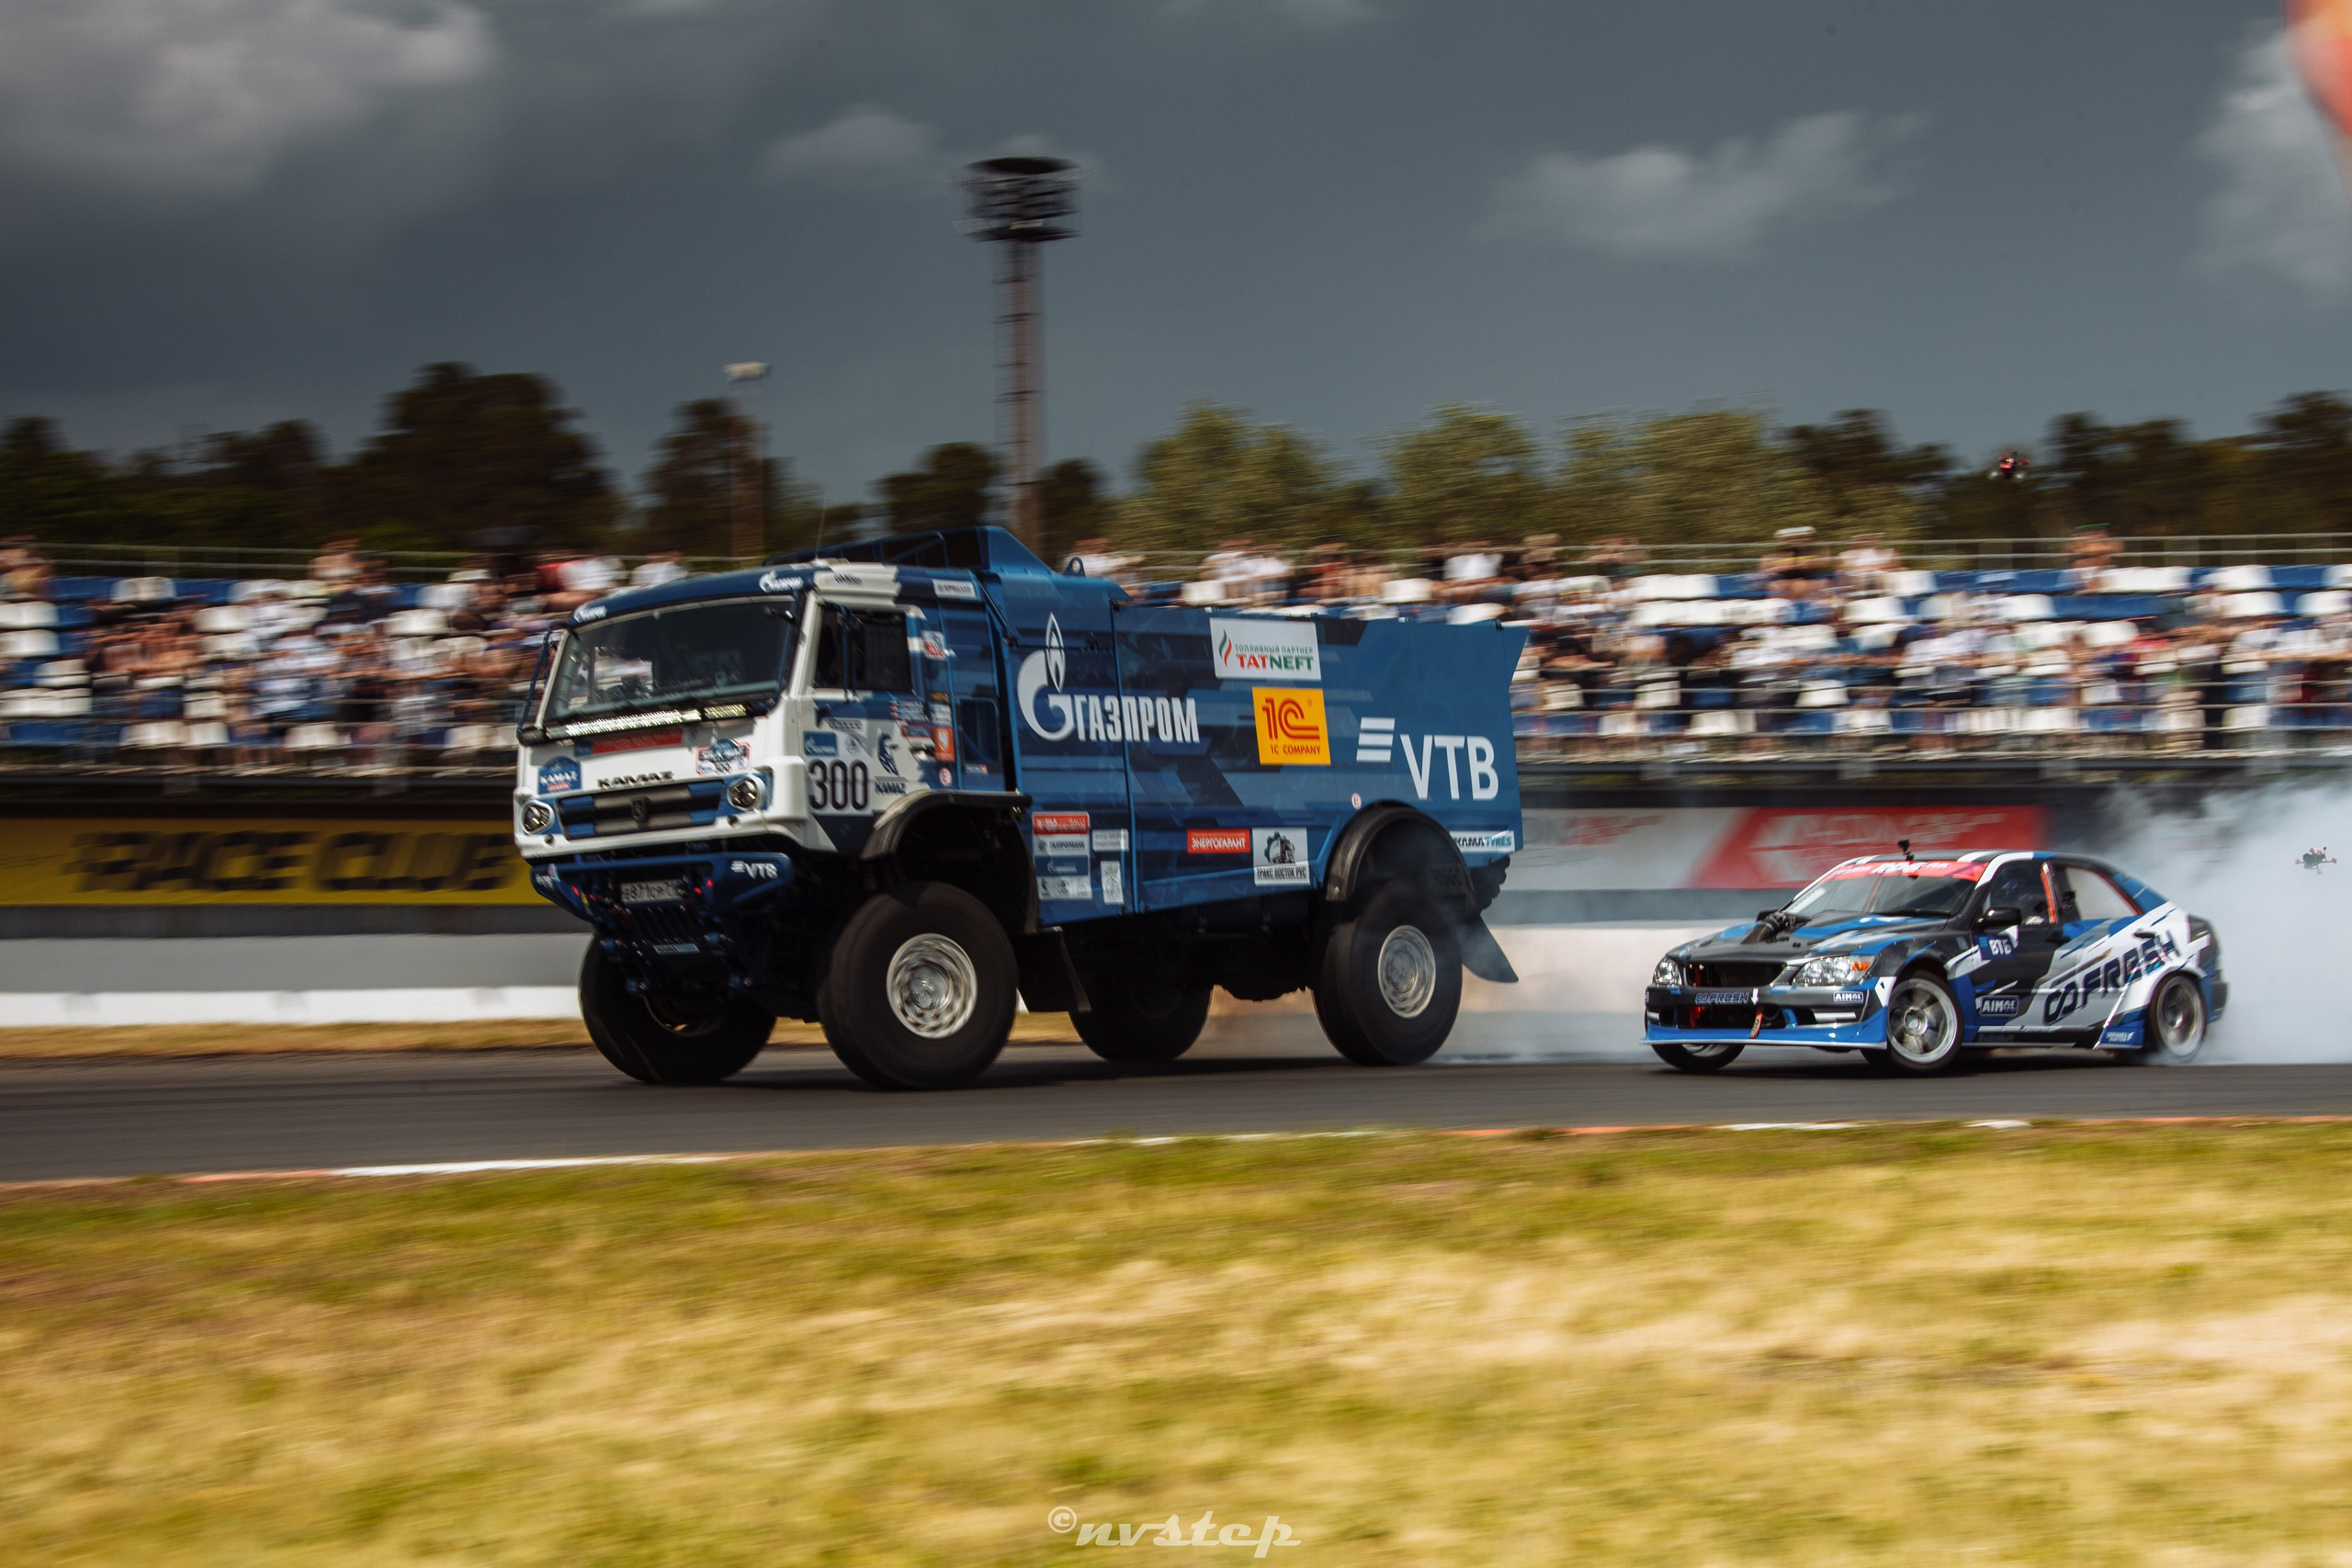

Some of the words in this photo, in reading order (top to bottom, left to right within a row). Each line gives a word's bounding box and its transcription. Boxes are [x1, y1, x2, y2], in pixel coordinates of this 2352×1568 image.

[1236, 654, 1314, 671] TATNEFT
[1073, 694, 1201, 744] ГАЗПРОМ
[1283, 744, 1321, 756] COMPANY
[1399, 734, 1499, 801] VTB
[597, 771, 676, 790] KAMAZ
[808, 758, 868, 810] 300
[1191, 837, 1247, 850] ЭНЕРГОГАРАНТ
[745, 863, 778, 879] VTB
[1274, 867, 1295, 879] ВОСТОК
